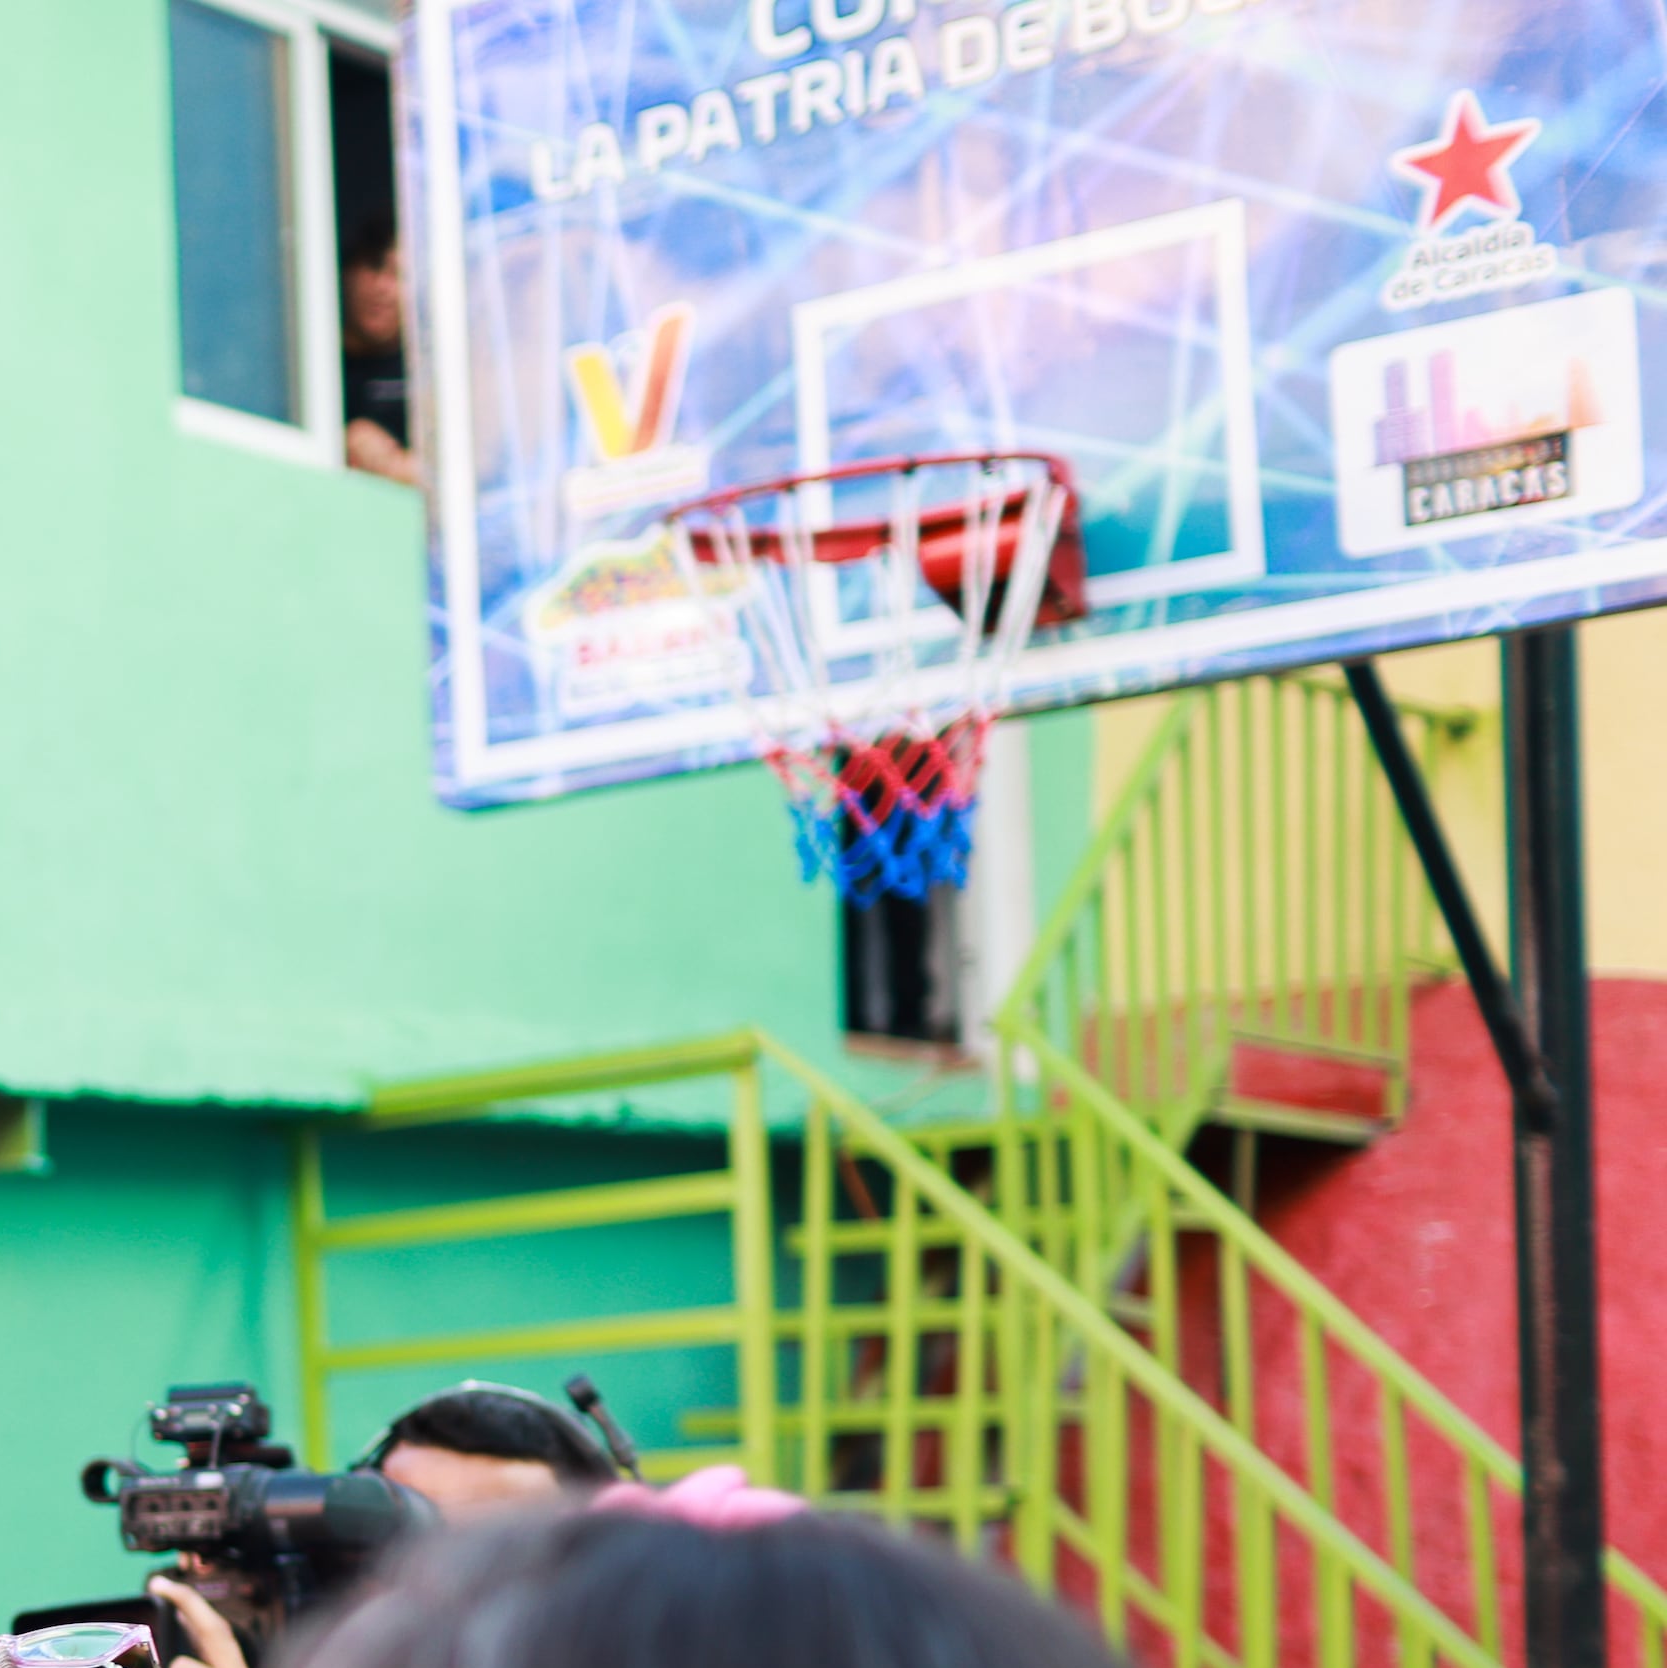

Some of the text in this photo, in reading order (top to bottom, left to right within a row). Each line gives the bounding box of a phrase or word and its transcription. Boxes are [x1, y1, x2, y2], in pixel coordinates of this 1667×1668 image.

[528, 121, 626, 200] LA
[635, 34, 926, 174] PATRIA
[938, 2, 1055, 89] DE
[1390, 250, 1550, 300] de Caracas
[1407, 461, 1567, 523] CARACAS
